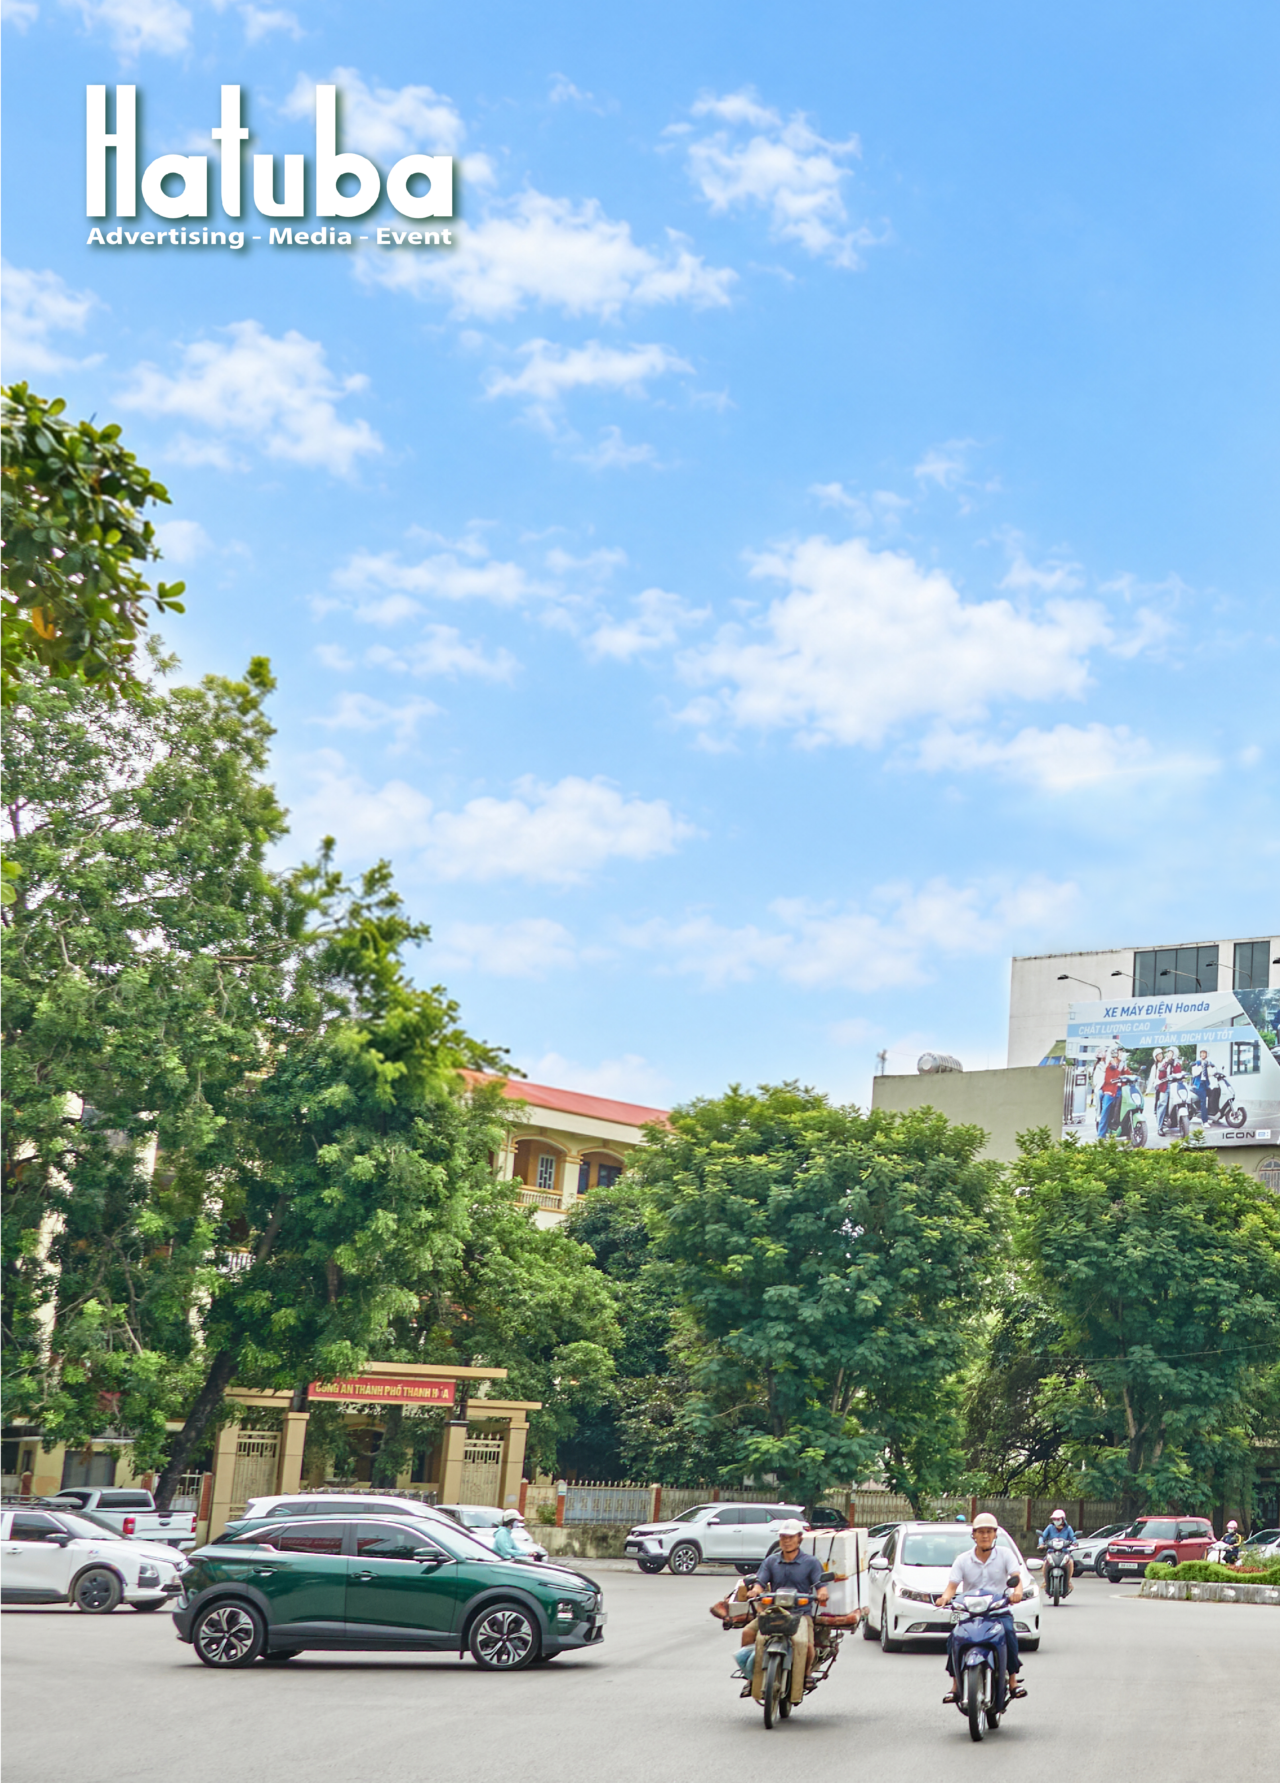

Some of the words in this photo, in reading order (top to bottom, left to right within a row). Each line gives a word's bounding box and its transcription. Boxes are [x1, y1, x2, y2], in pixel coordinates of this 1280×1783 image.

[1103, 1006, 1119, 1018] XE
[1120, 1002, 1144, 1017] MÁY
[1145, 1001, 1173, 1017] ĐIỆN
[1175, 1001, 1210, 1013] Honda
[1078, 1022, 1101, 1035] CHẤT
[1101, 1023, 1131, 1035] LƯỢNG
[1132, 1022, 1151, 1032] CAO
[1139, 1035, 1153, 1045] AN
[1180, 1032, 1203, 1045] DỊCH
[1203, 1031, 1215, 1043] VỤ
[1217, 1027, 1234, 1040] TỐT
[1222, 1131, 1255, 1139] ICON
[403, 1386, 431, 1398] THANH
